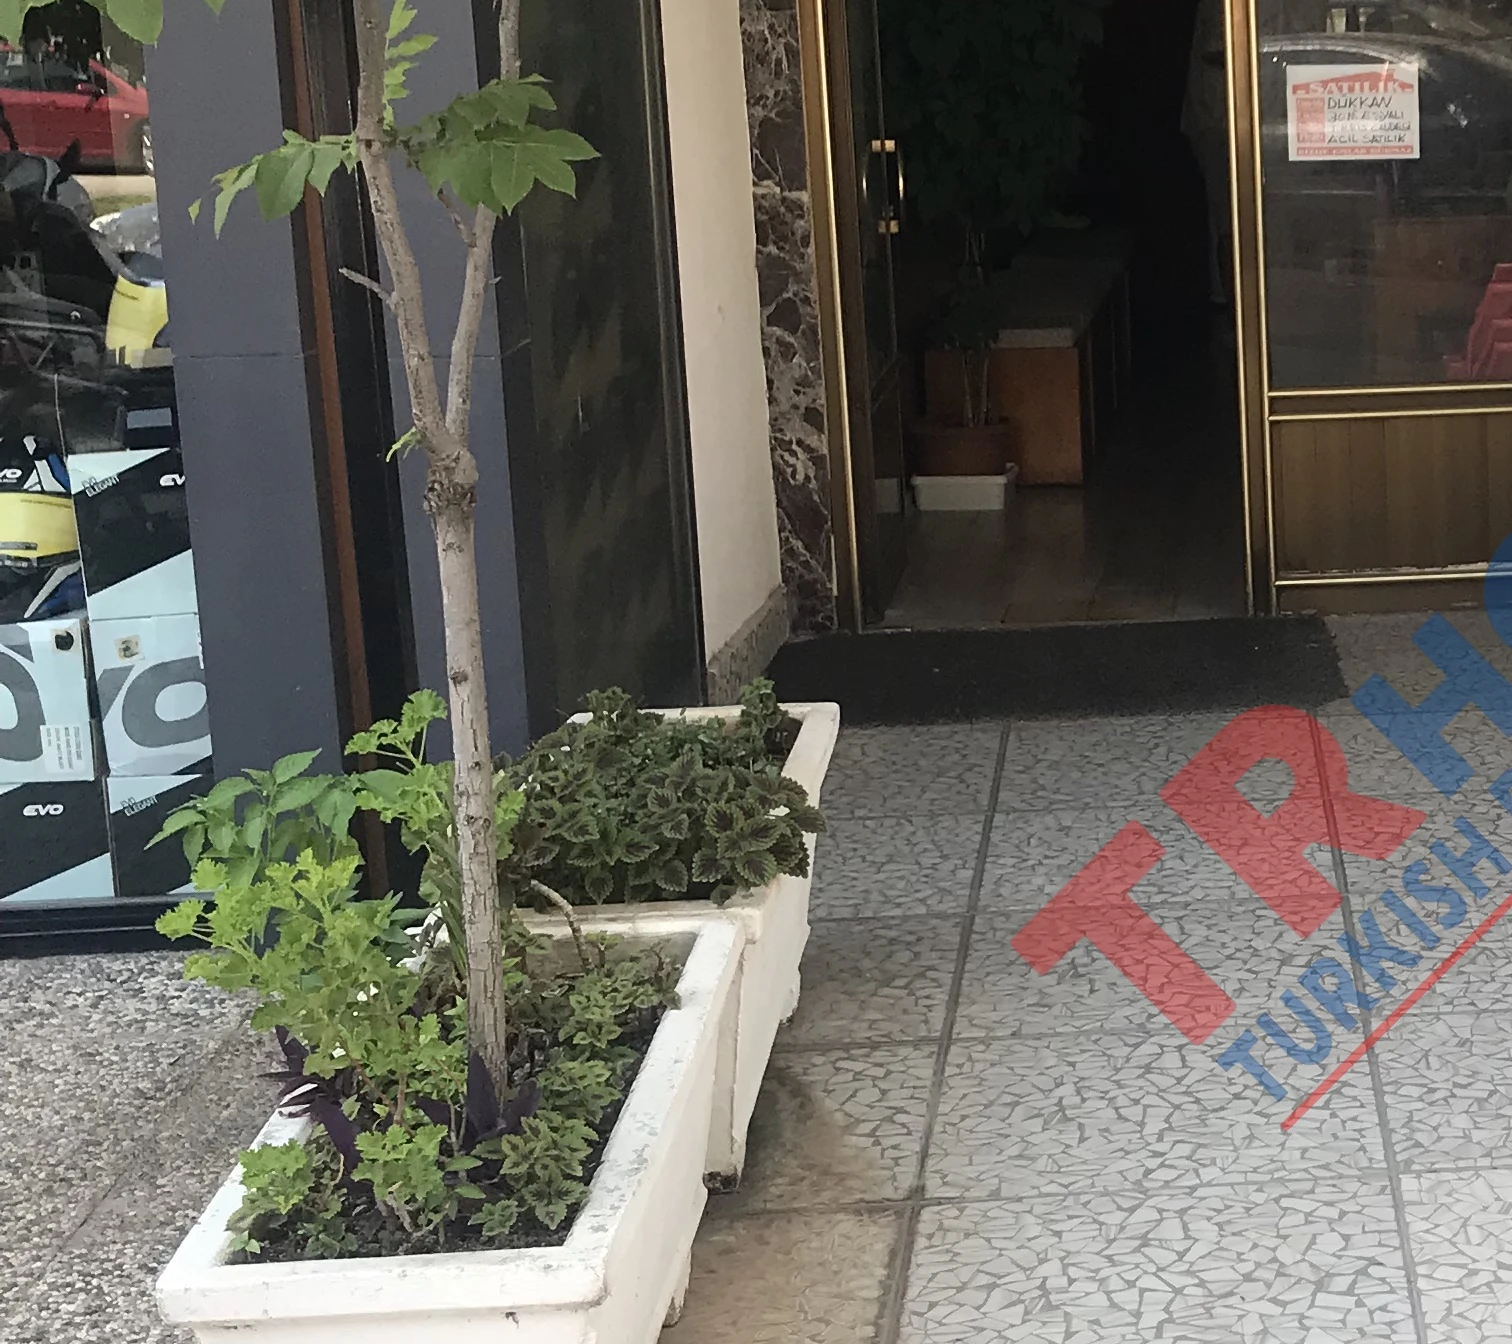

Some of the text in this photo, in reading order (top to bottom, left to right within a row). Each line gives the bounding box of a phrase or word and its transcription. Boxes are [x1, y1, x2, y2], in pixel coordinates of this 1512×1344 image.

[1309, 81, 1400, 95] SATILIK
[22, 804, 64, 817] EVO
[124, 795, 159, 817] ELEGANT
